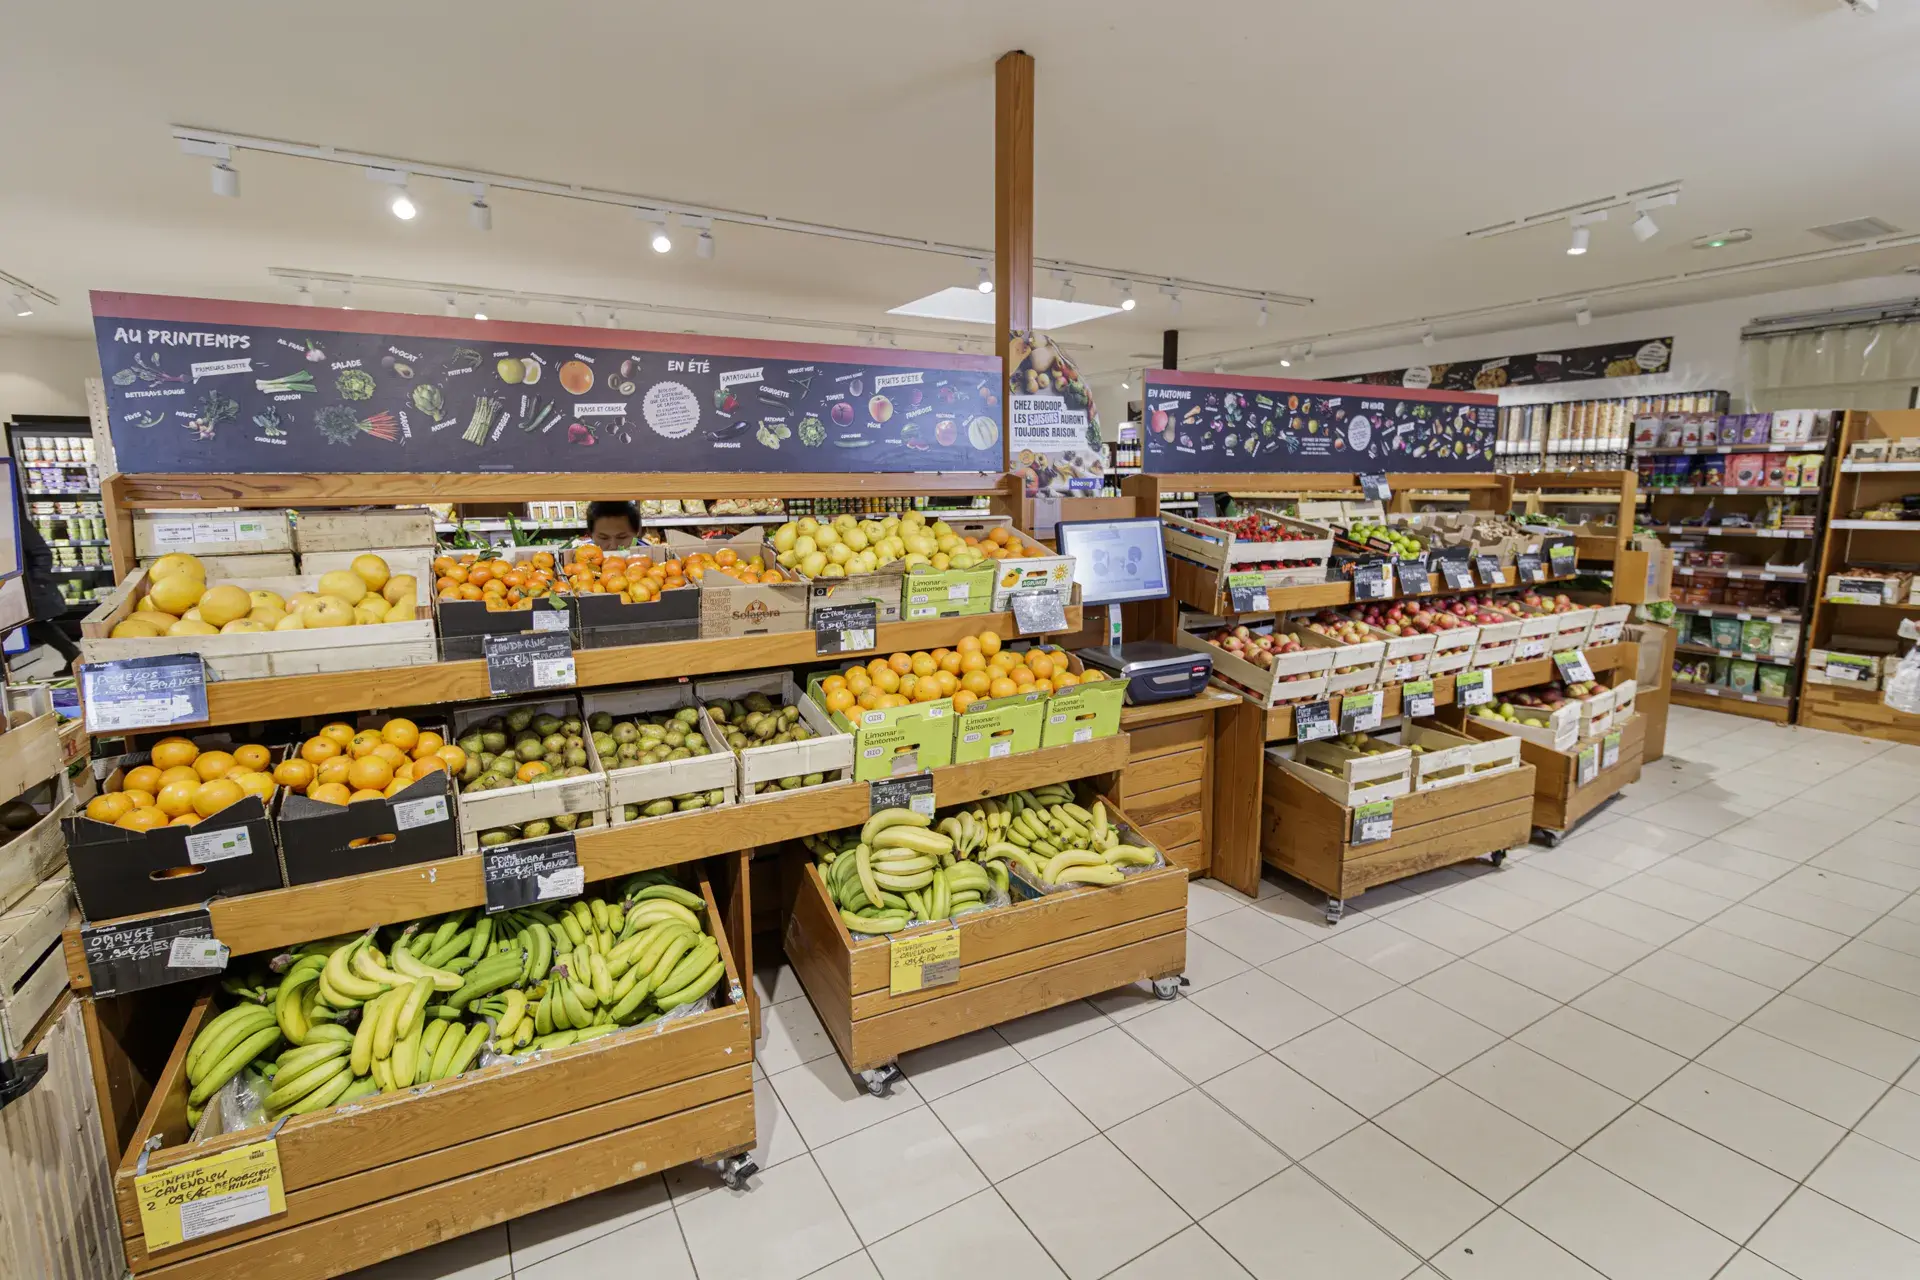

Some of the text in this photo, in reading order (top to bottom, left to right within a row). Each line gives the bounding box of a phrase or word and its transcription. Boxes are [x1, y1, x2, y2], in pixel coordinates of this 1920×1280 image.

[114, 327, 251, 349] AU PRINTEMPS
[389, 346, 417, 362] AVOCAT
[195, 362, 246, 374] PRIMEURS BOTTE
[331, 359, 362, 370] SALADE
[667, 359, 711, 373] EN ÉTÉ
[721, 372, 760, 382] RATATOUILLE
[877, 377, 900, 386] FRUITS
[125, 388, 185, 398] BETTERAVE ROUGE
[759, 385, 790, 399] COURGETTE
[825, 393, 845, 402] TOMATE
[1148, 389, 1191, 399] EN AUTOMNE
[1014, 400, 1062, 411] CHEZ BIOCOOP,
[1361, 401, 1369, 409] EN
[175, 410, 197, 419] NAVET
[906, 405, 933, 419] FRAMBOISE
[399, 411, 412, 438] CAROTTE
[1014, 413, 1084, 425] LES SAISONS AURONT
[492, 412, 511, 441] ASPERGES
[1014, 427, 1077, 437] TOUJOURS RAISON.
[1071, 479, 1093, 489] biocoop
[490, 638, 547, 654] MANDARINE
[97, 671, 158, 685] POMELOS
[1053, 705, 1084, 713] Santomera
[965, 722, 1000, 731] Santomera
[966, 717, 994, 725] Limonar
[865, 730, 897, 739] Limonar
[864, 736, 905, 746] Santomera
[491, 854, 516, 865] POIRE
[91, 927, 155, 946] ORANGE
[152, 1171, 173, 1179] Produit
[155, 1170, 227, 1198] CAVENDISH
